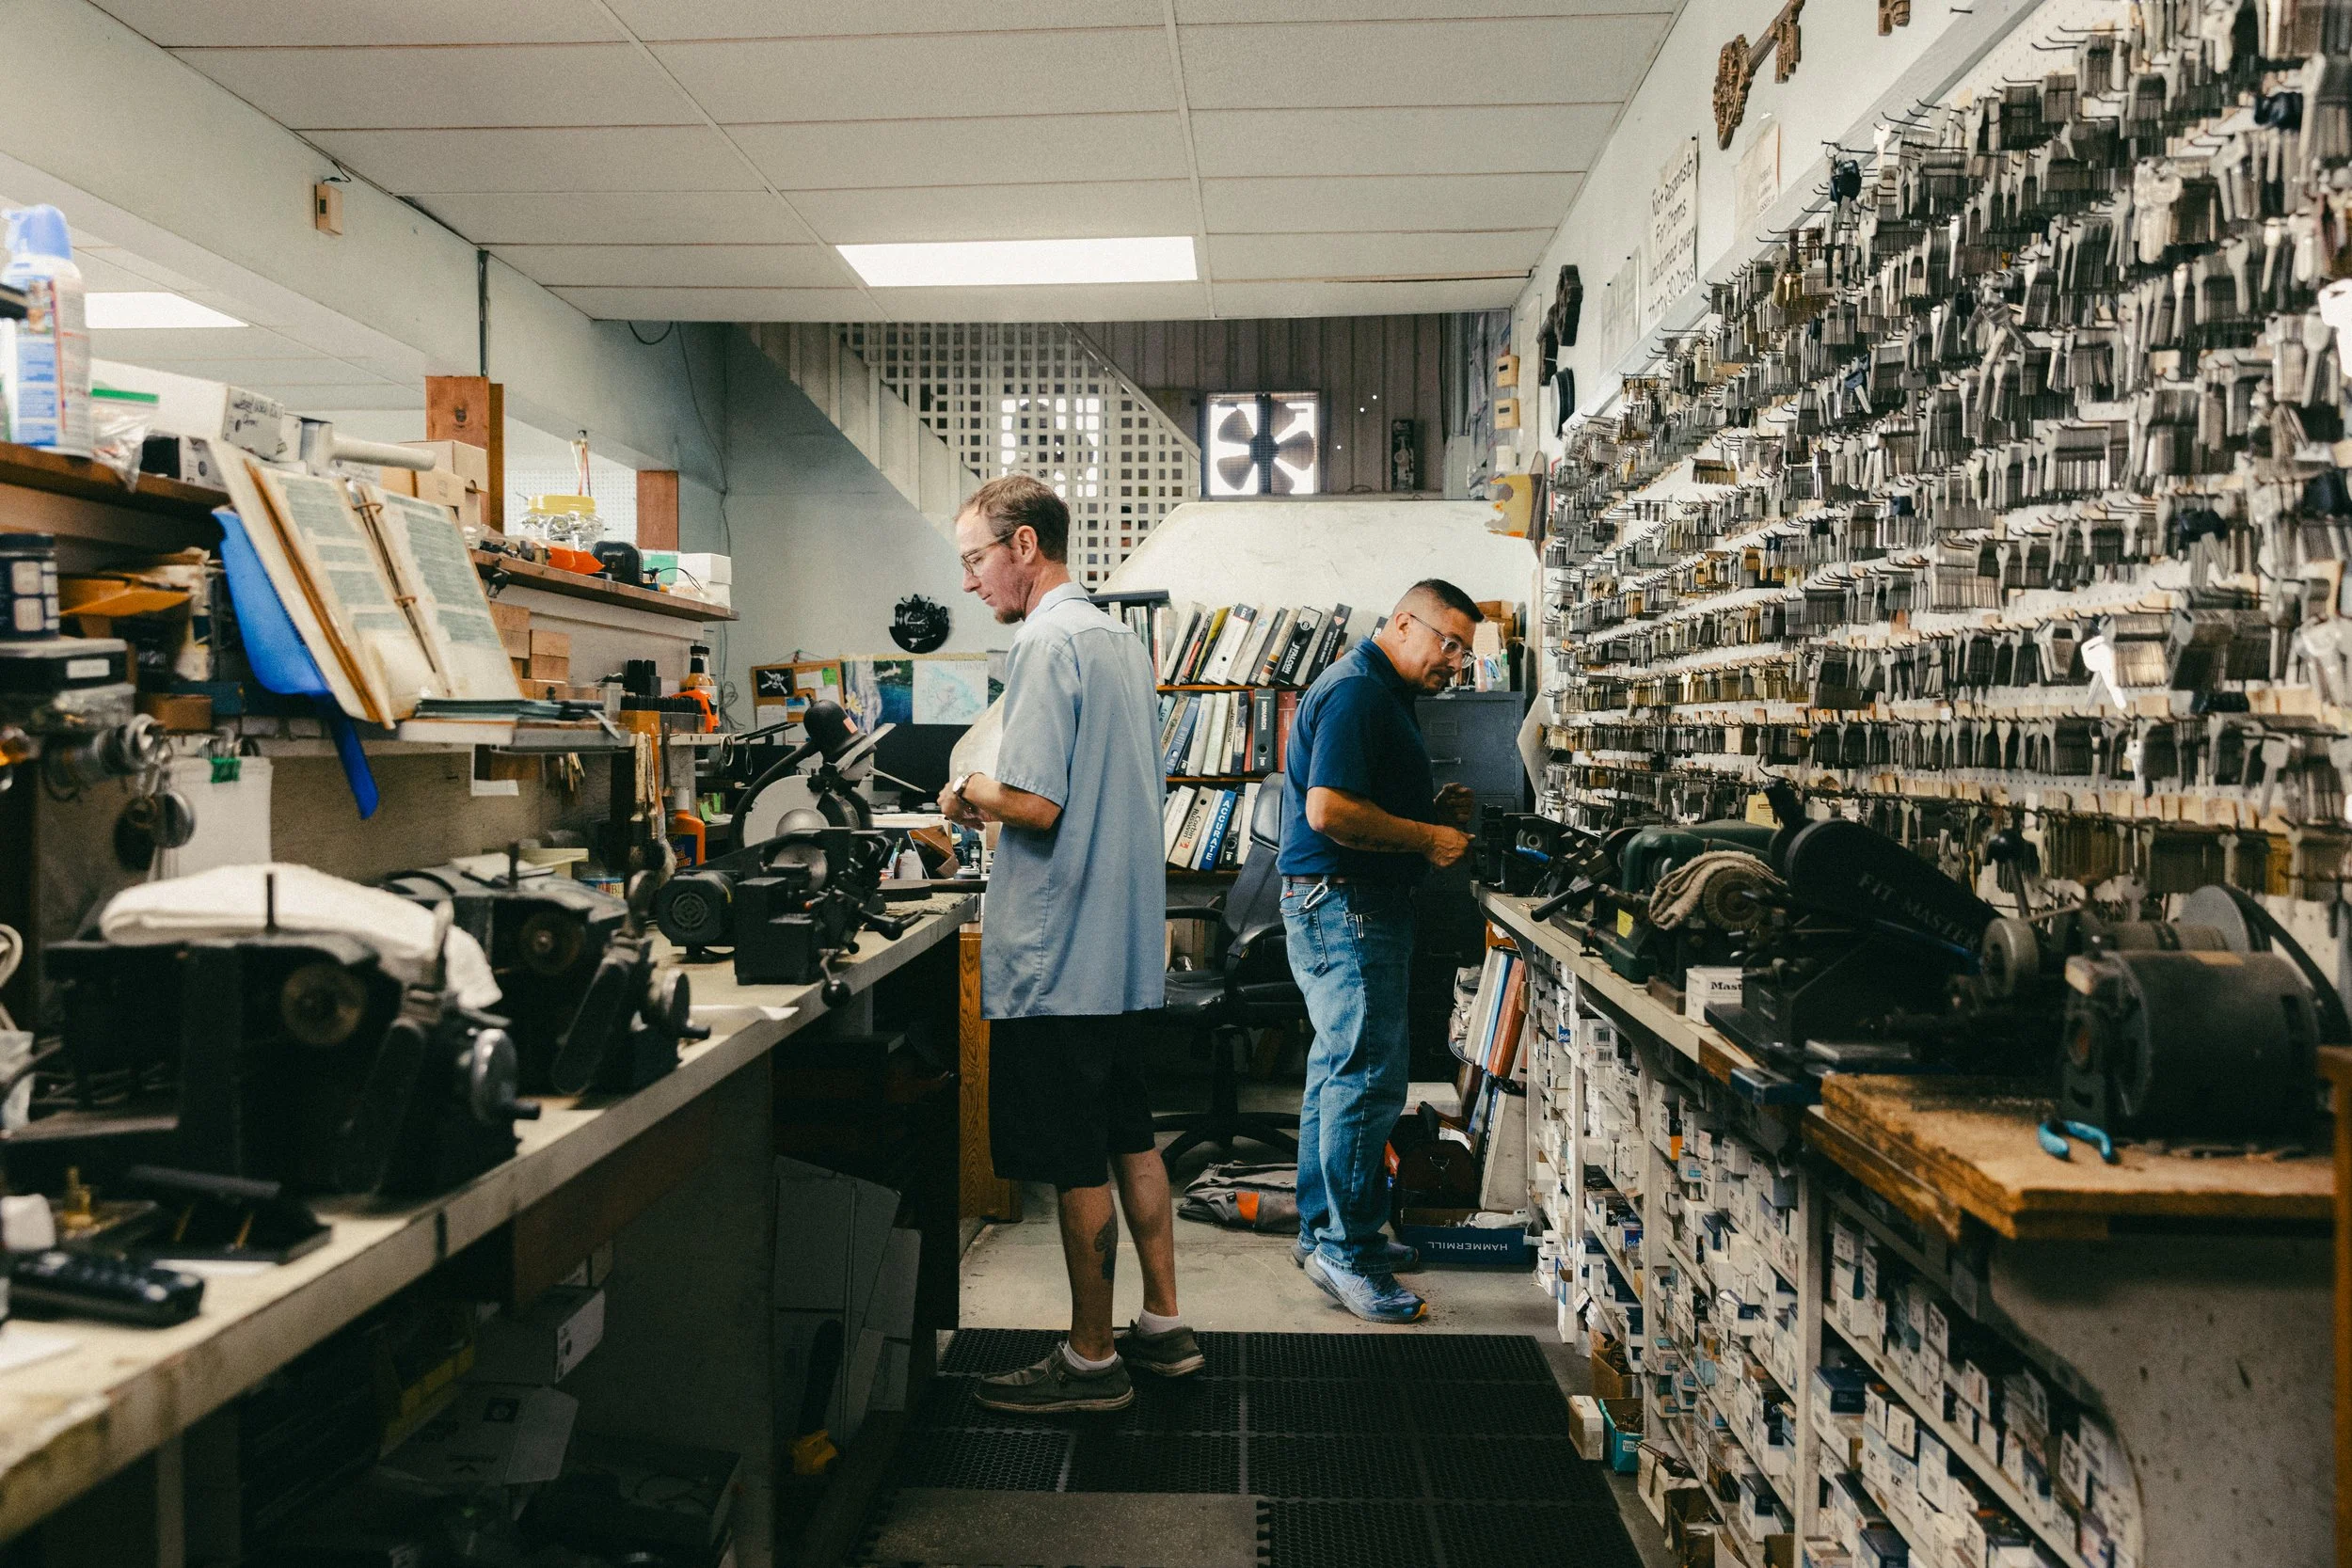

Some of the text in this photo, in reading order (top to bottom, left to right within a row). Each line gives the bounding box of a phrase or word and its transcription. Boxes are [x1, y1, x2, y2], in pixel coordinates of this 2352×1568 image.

[1664, 152, 1693, 204] Responsib
[1677, 262, 1695, 295] Days
[1284, 644, 1300, 674] FALCON
[1184, 808, 1200, 838] Russwin
[1187, 816, 1201, 840] Corbin
[1205, 800, 1231, 861] ACCURATE
[1710, 981, 1743, 990] Mast
[1427, 1241, 1508, 1251] HAMMERMILL
